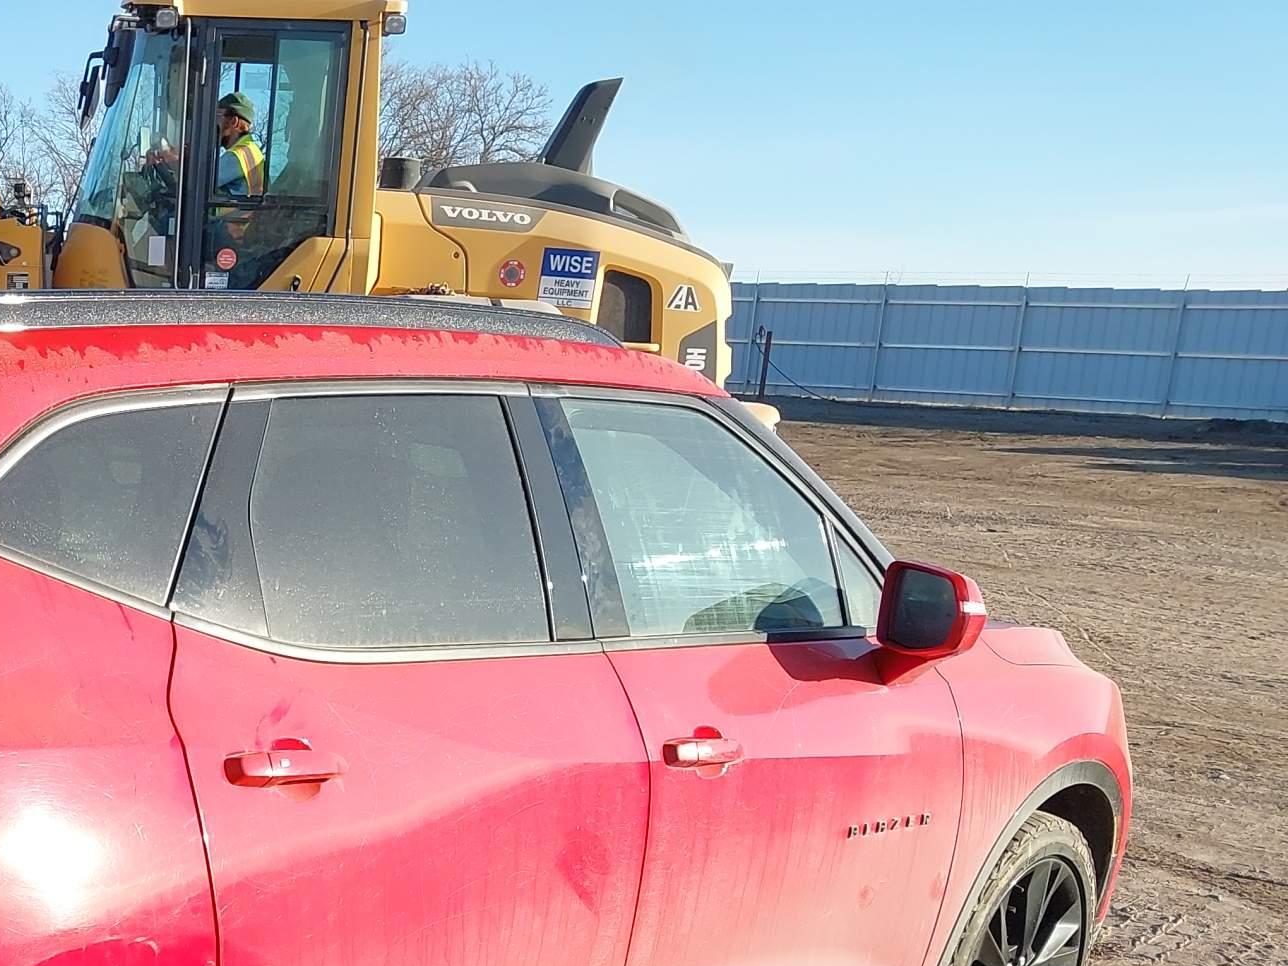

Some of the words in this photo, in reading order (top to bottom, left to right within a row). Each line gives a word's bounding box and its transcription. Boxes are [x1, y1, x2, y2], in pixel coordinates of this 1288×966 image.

[440, 205, 532, 225] VOLVO
[549, 254, 593, 274] WISE
[554, 279, 581, 288] HEAVY
[543, 286, 589, 299] EQUIPMENT
